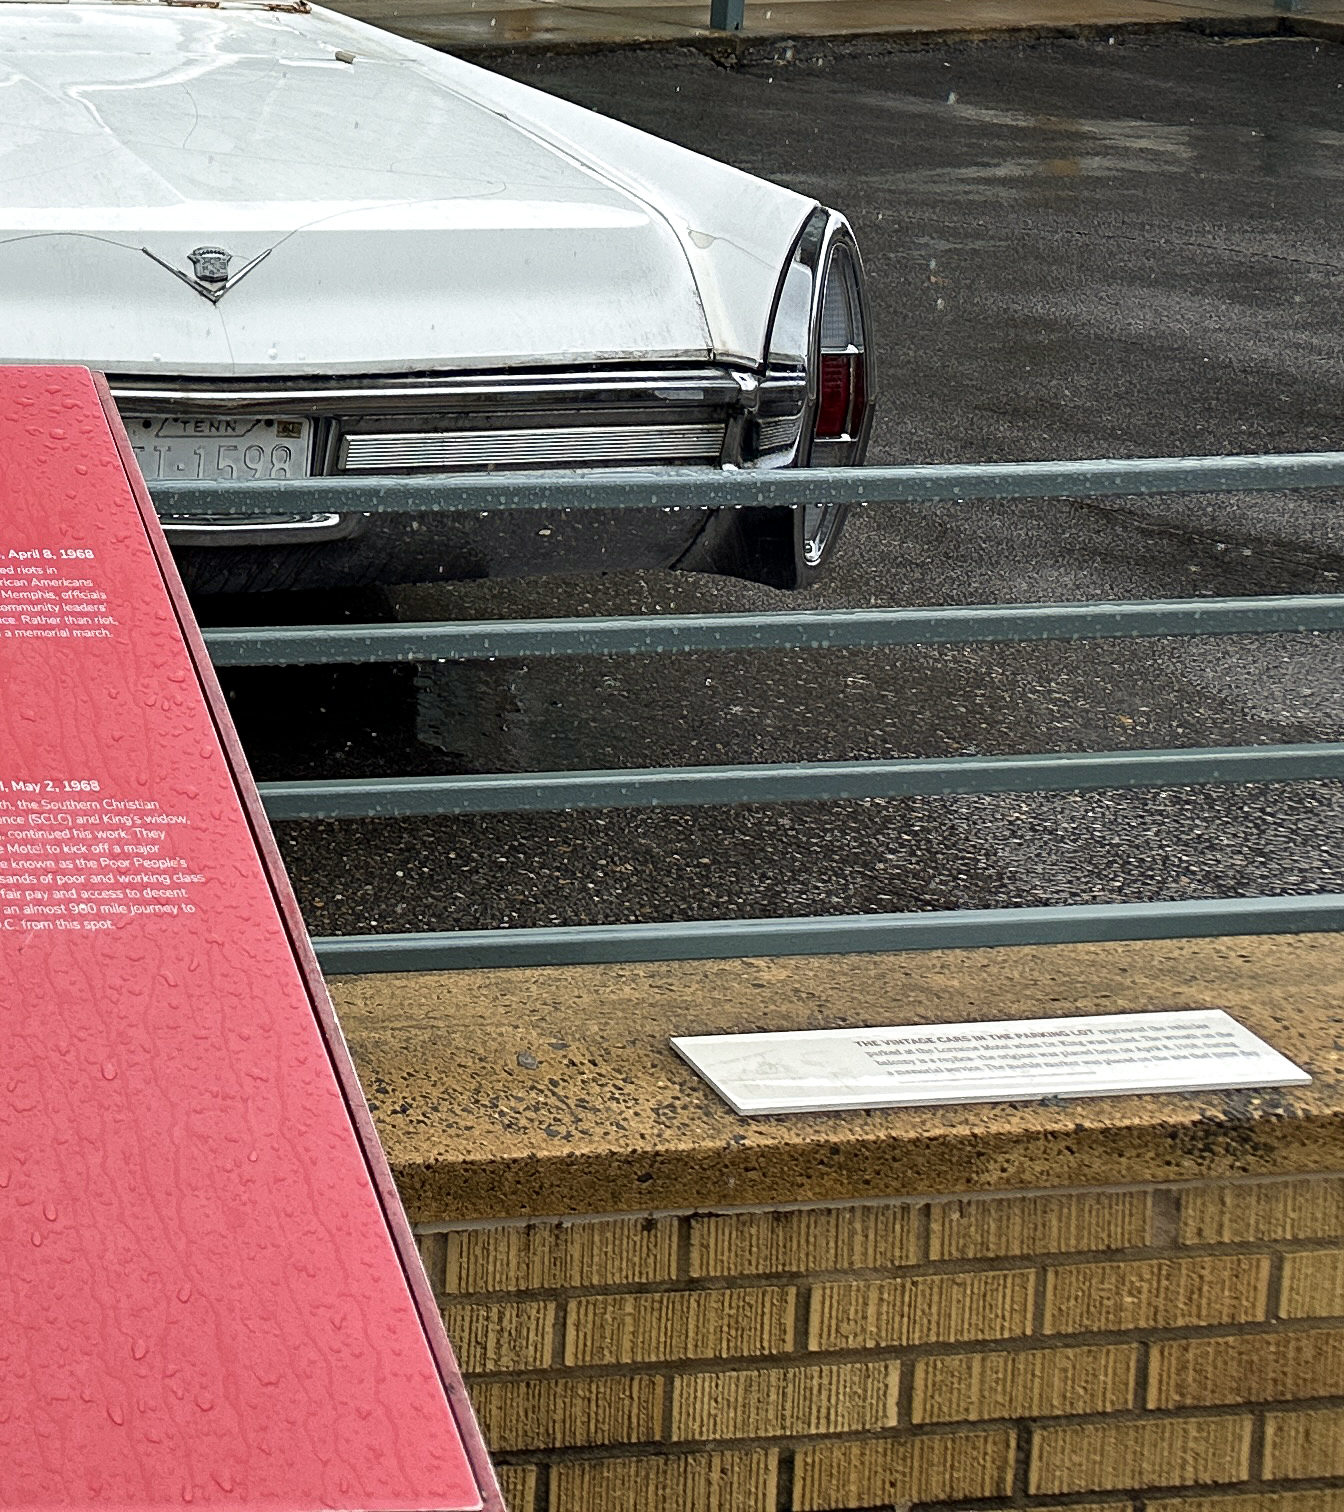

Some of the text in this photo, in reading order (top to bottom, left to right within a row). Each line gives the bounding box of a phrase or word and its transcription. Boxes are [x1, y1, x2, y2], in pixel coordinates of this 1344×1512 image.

[180, 420, 237, 433] TENN
[8, 549, 40, 560] April
[42, 549, 56, 559] 8,
[59, 549, 94, 558] 1968
[16, 566, 43, 574] riots
[46, 566, 57, 574] in
[11, 780, 40, 793] May
[43, 780, 59, 792] 2,
[62, 780, 100, 791] 1968
[16, 799, 39, 809] the
[40, 799, 100, 809] Southern
[102, 798, 159, 809] Christian
